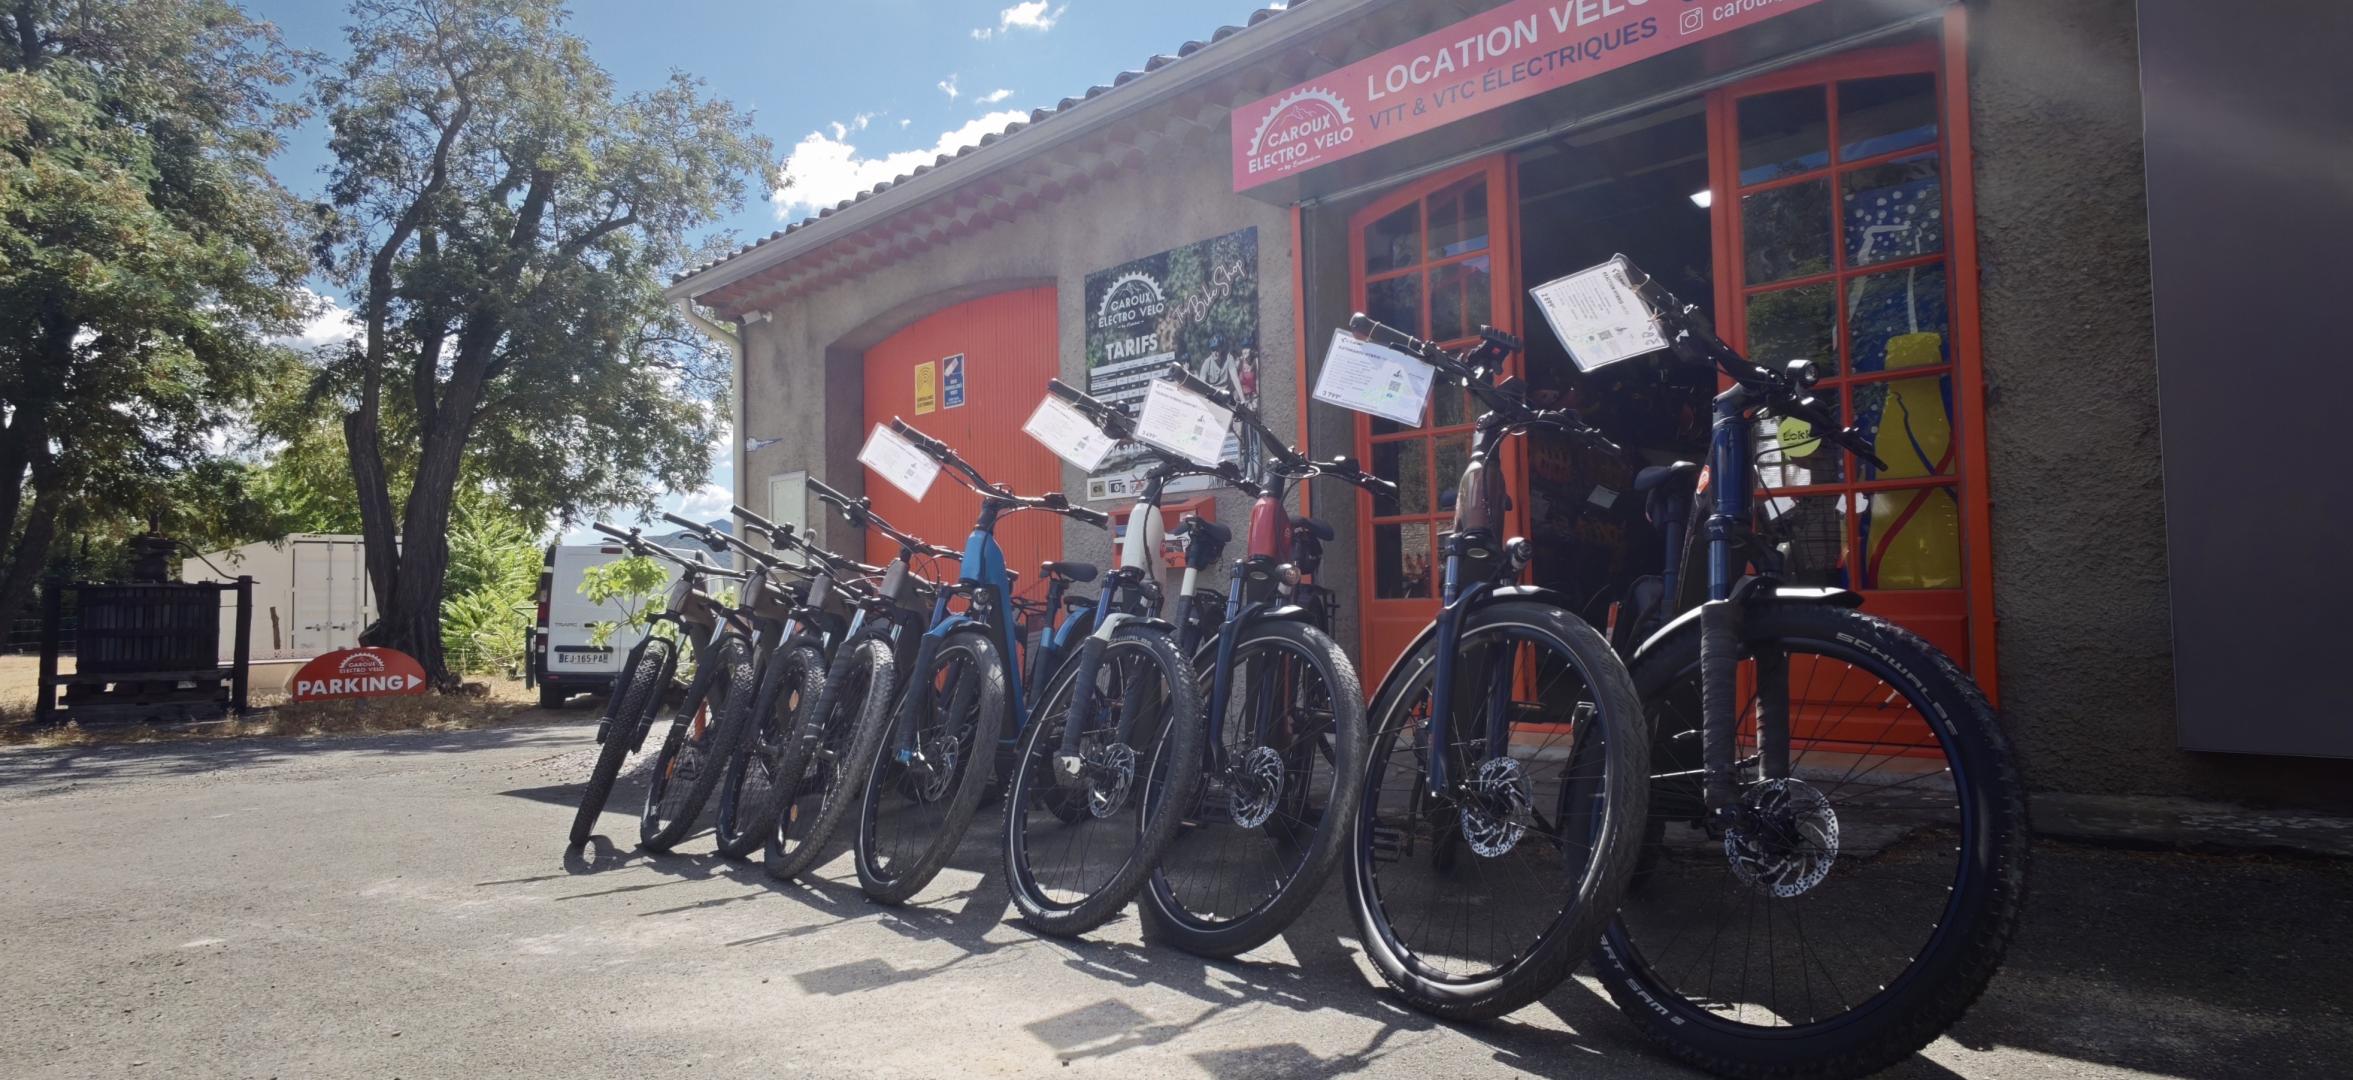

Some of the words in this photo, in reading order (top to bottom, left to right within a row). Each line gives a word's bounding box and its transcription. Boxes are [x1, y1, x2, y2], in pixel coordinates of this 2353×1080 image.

[1367, 14, 1539, 102] LOCATION
[1548, 0, 1649, 34] VEL
[1369, 103, 1407, 130] VTT
[1412, 97, 1427, 116] &
[1433, 80, 1475, 108] VTC
[1482, 16, 1658, 93] ÉLECTRIQUES
[1268, 113, 1331, 147] CAROUX
[1248, 142, 1308, 174] ELECTRO
[1314, 126, 1354, 151] VELO
[1213, 259, 1246, 297] Shop
[1098, 309, 1136, 328] ELECTRO
[1139, 302, 1165, 317] VELO
[1110, 291, 1151, 312] CAROUX
[1105, 332, 1158, 361] TARIFS
[297, 674, 404, 696] PARKING
[1836, 631, 1959, 736] SCHWALBE
[1600, 933, 1625, 972] ART
[1625, 978, 1669, 1015] SAM
